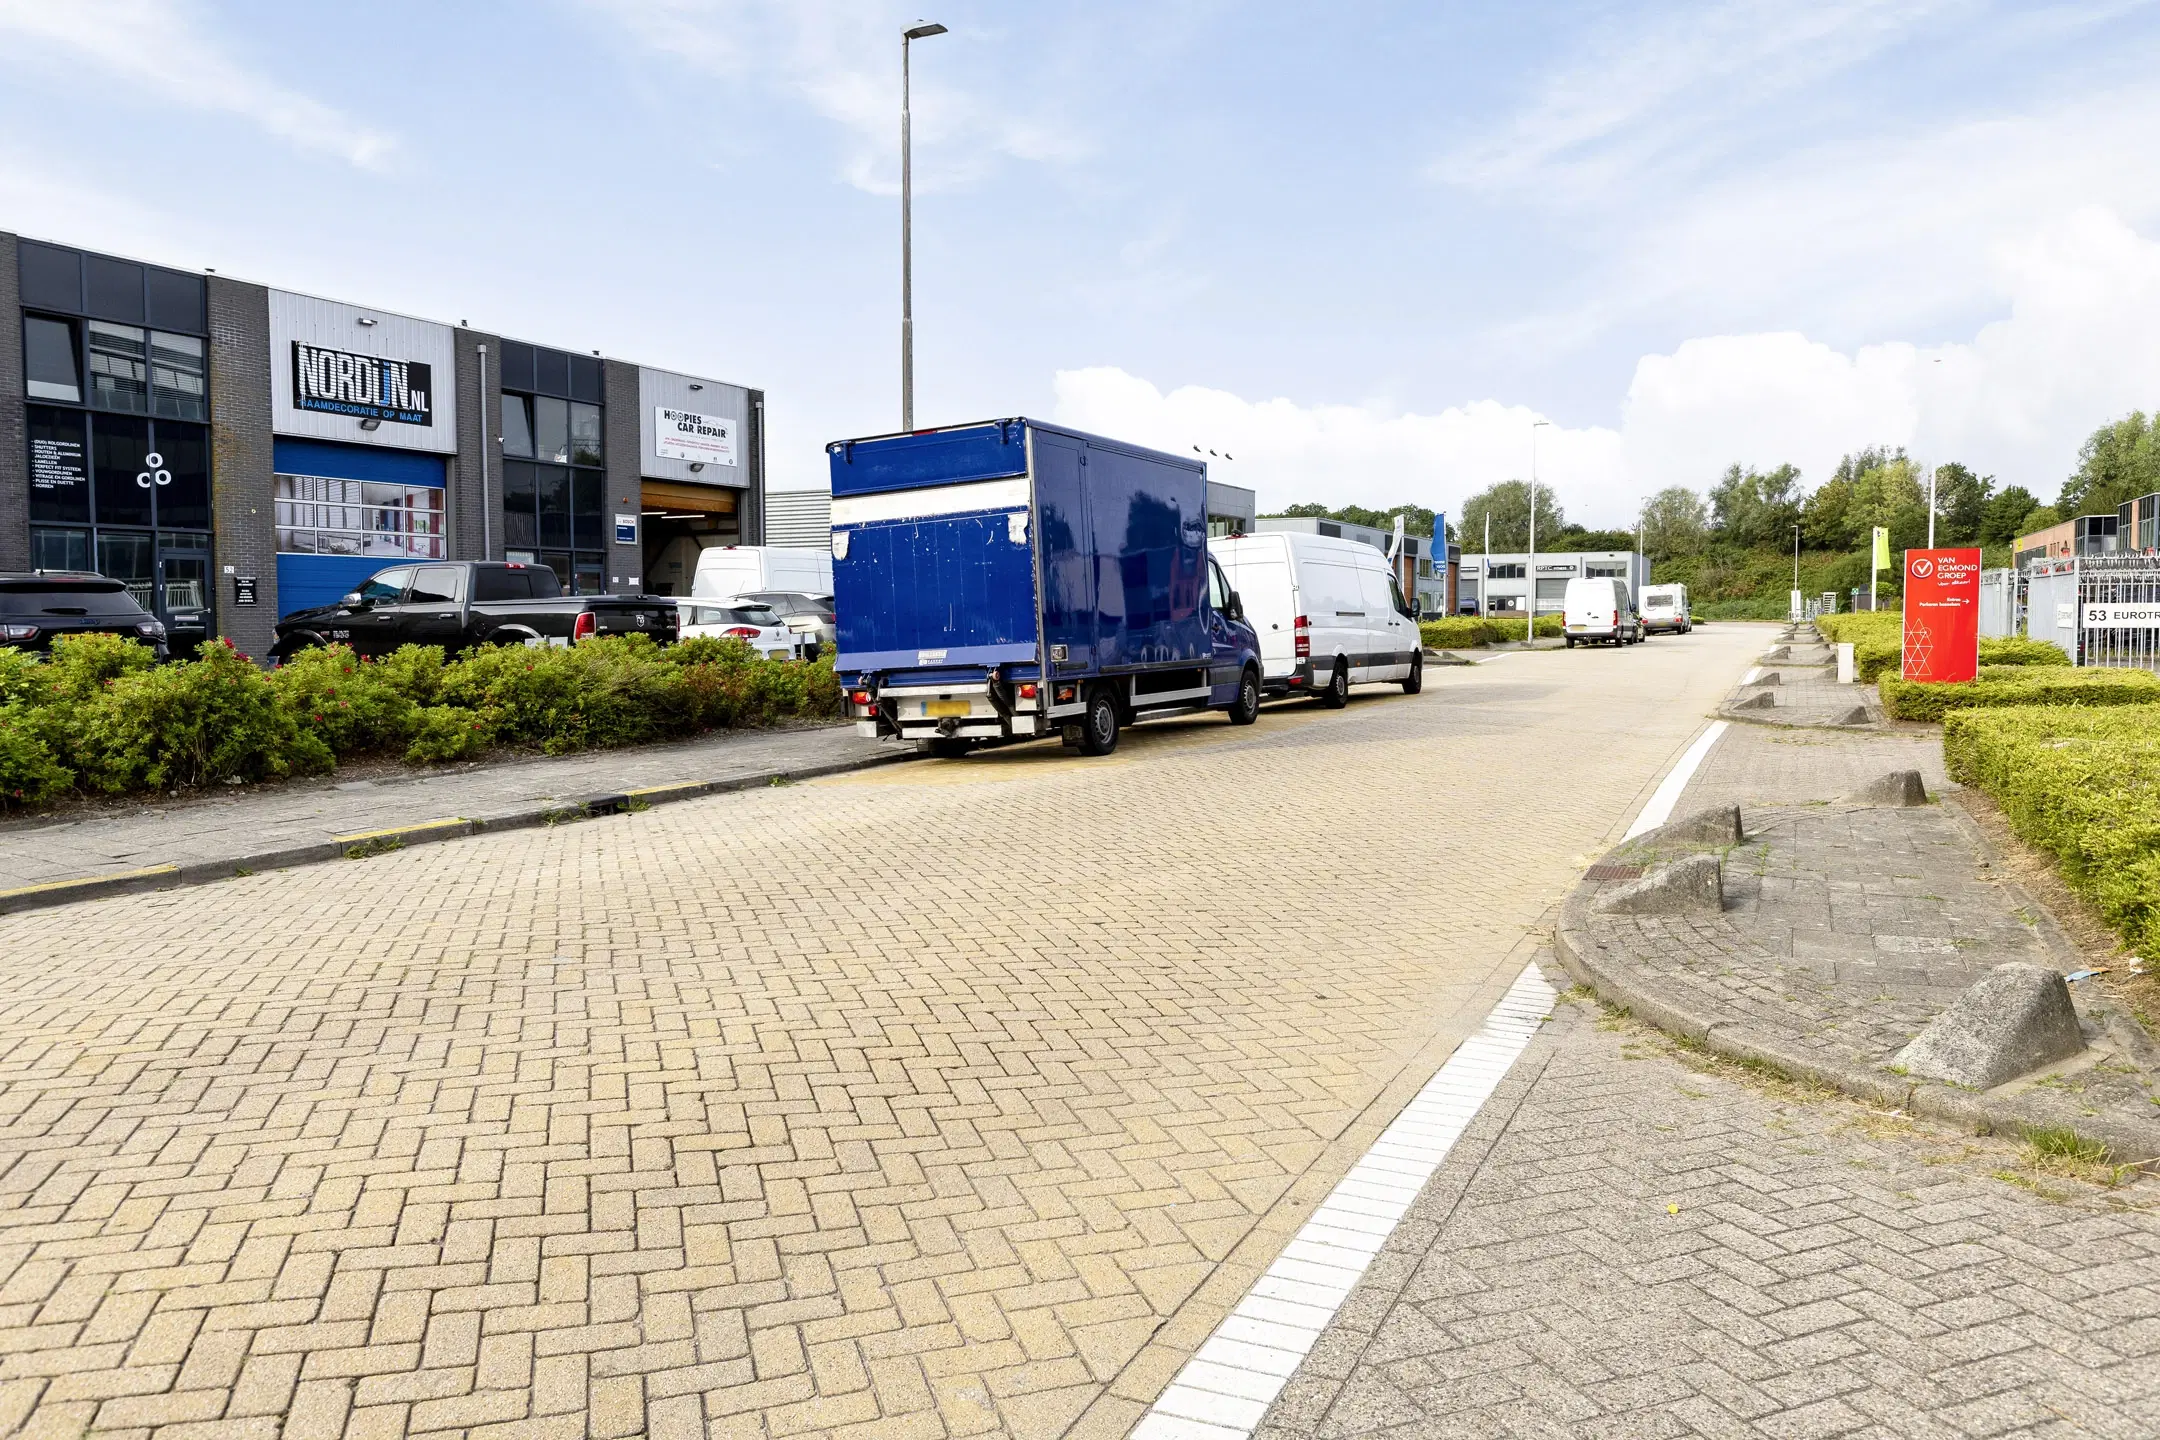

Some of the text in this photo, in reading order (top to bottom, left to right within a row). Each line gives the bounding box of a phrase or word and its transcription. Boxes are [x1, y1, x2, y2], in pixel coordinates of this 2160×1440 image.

[382, 409, 395, 418] OP
[399, 412, 423, 422] MAAT
[664, 409, 702, 425] HOOPIES
[677, 422, 694, 433] CAR
[697, 425, 726, 438] REPAIR
[2089, 610, 2107, 621] 53
